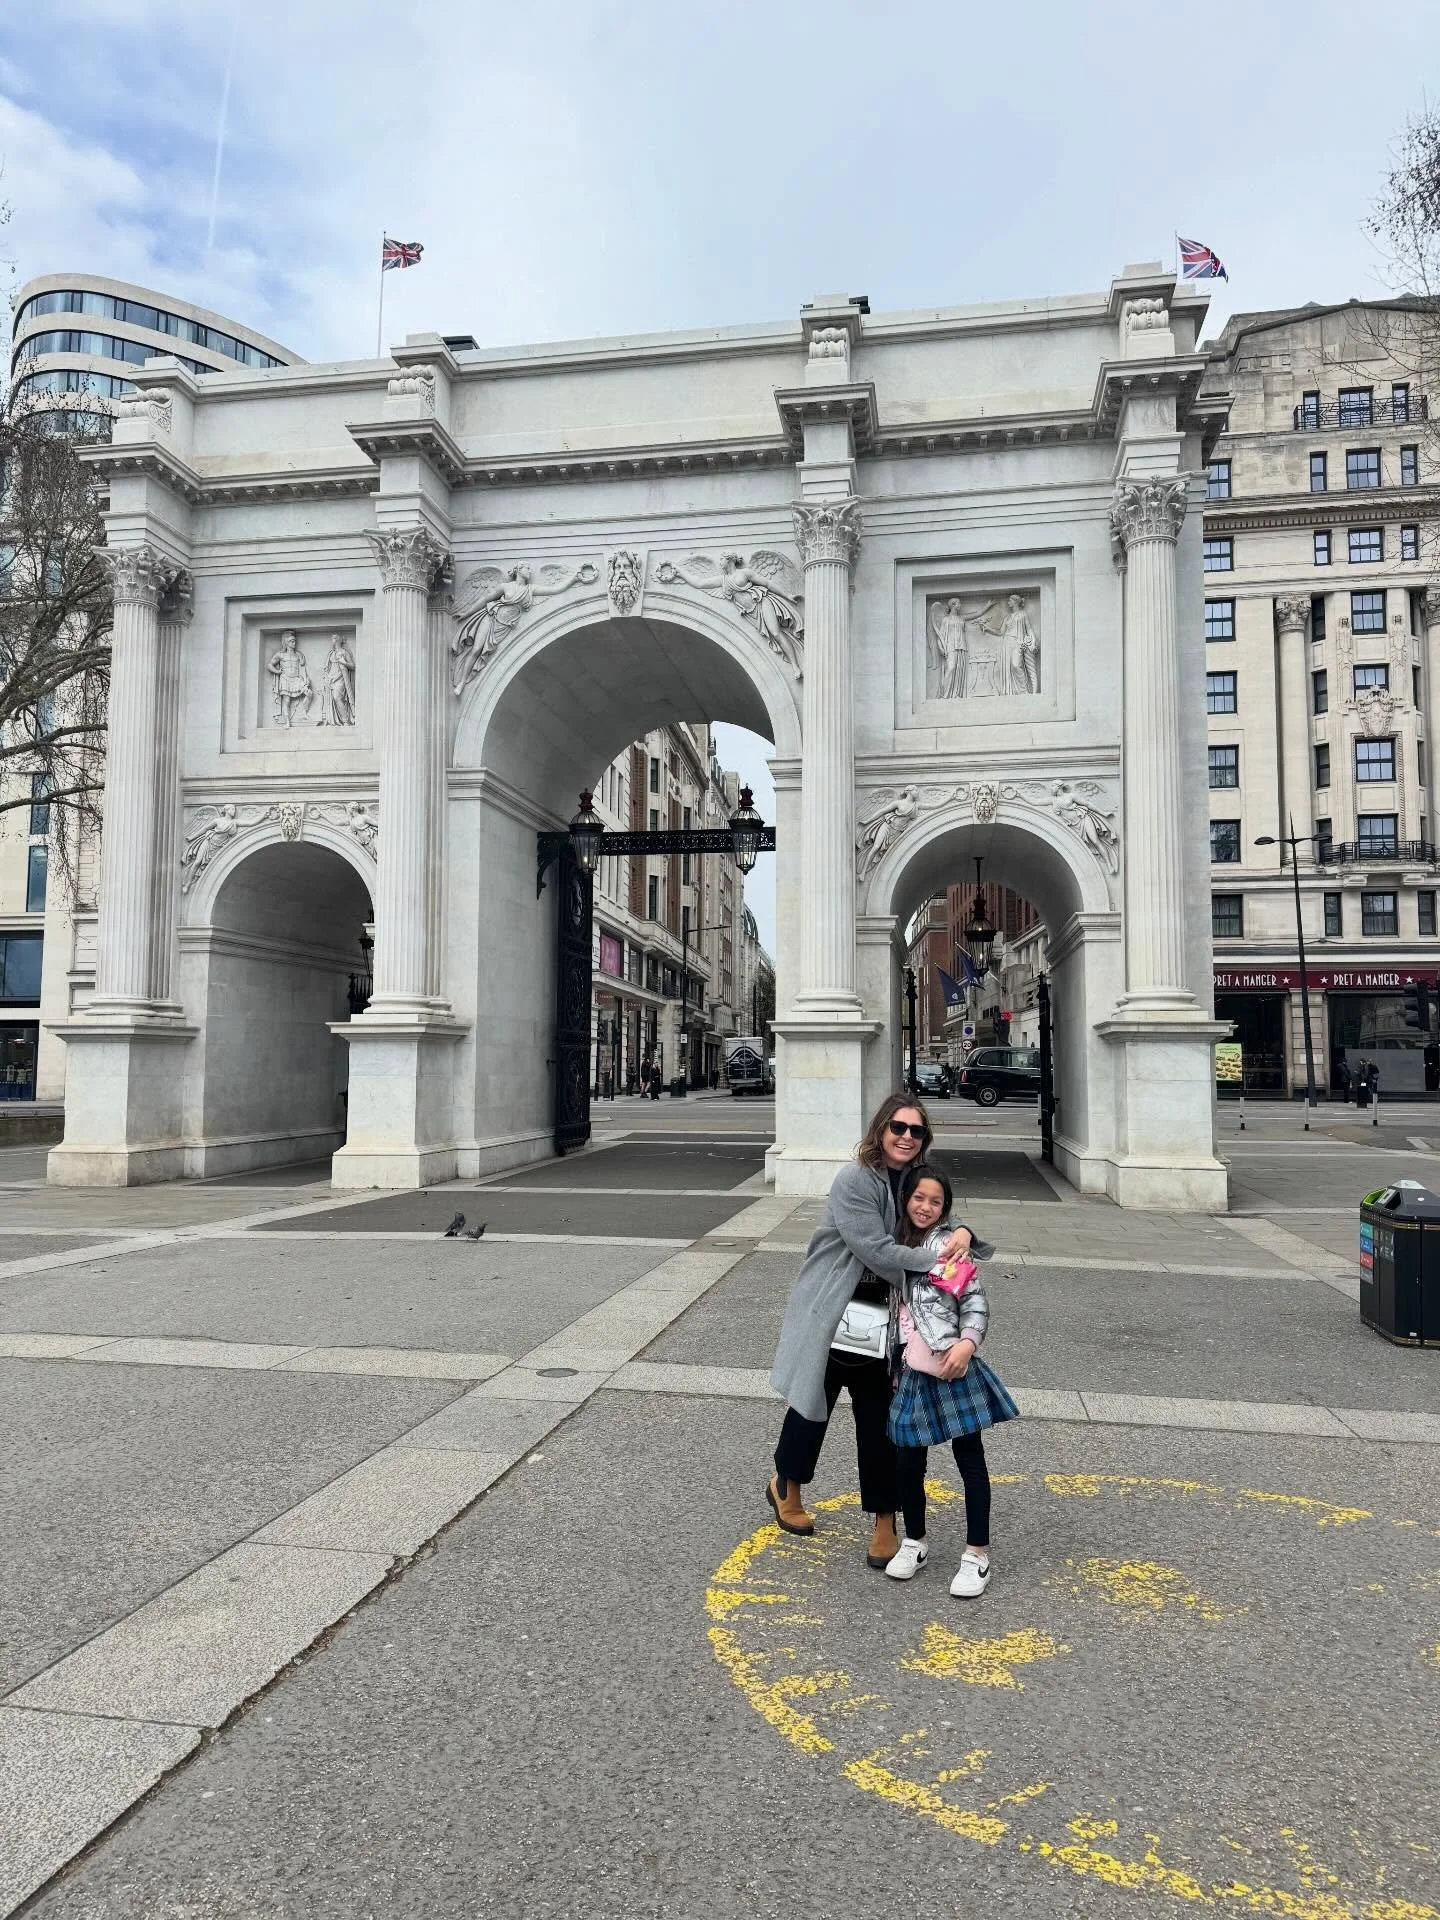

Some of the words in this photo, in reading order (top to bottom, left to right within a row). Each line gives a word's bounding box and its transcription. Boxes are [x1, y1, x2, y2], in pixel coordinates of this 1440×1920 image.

[1235, 975, 1240, 986] A
[1243, 974, 1277, 986] MANGER
[1333, 973, 1354, 986] PRET
[1356, 974, 1362, 986] A
[1365, 973, 1400, 986] MANGER
